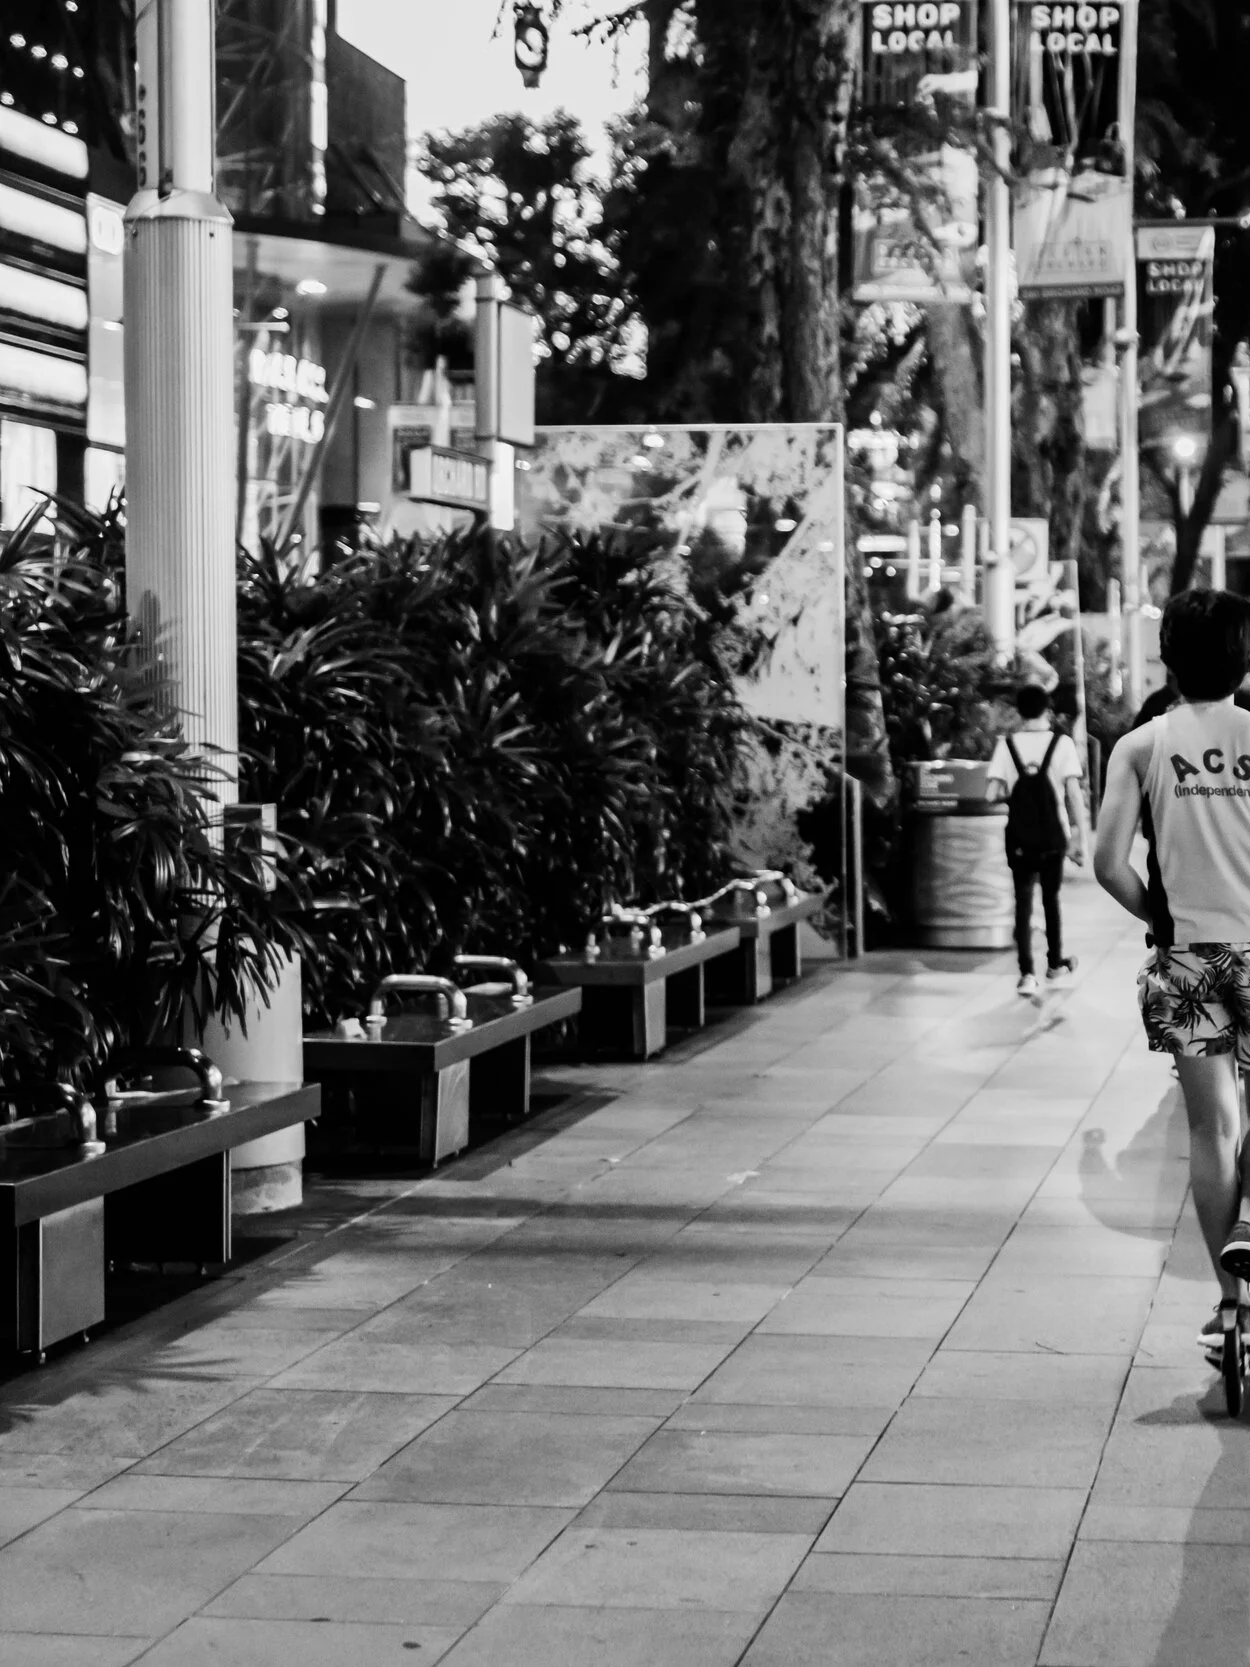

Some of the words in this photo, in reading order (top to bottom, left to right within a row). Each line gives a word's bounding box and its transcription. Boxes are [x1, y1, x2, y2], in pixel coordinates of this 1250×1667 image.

[872, 2, 961, 30] SHOP
[1030, 4, 1120, 30] SHOP
[871, 29, 961, 54] LOCAL
[1029, 31, 1119, 56] LOCAL
[1146, 261, 1204, 278] SHOP
